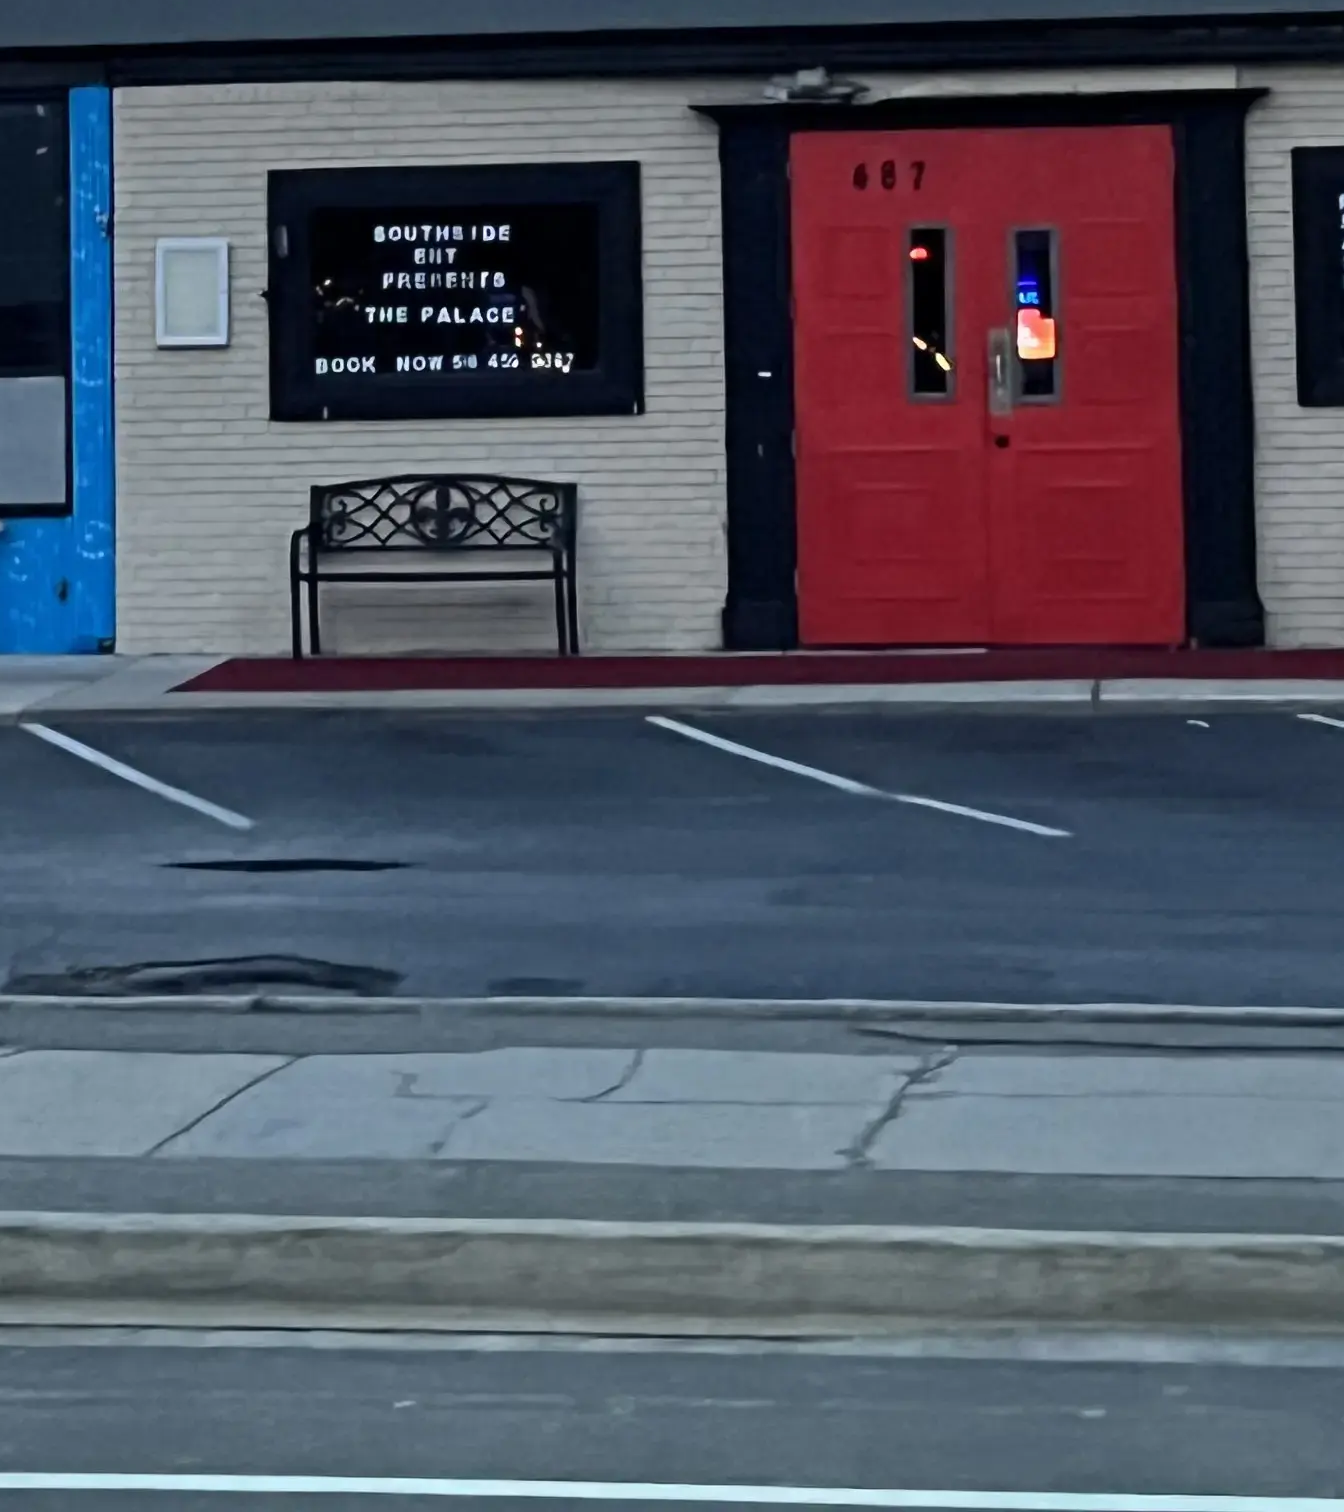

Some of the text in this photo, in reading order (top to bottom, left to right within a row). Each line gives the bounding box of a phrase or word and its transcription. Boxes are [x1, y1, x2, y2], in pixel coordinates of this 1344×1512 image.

[373, 224, 511, 243] SOUTHSIDE
[364, 306, 515, 324] THE PALACE
[315, 356, 376, 374] BOOK
[396, 355, 444, 373] NOW
